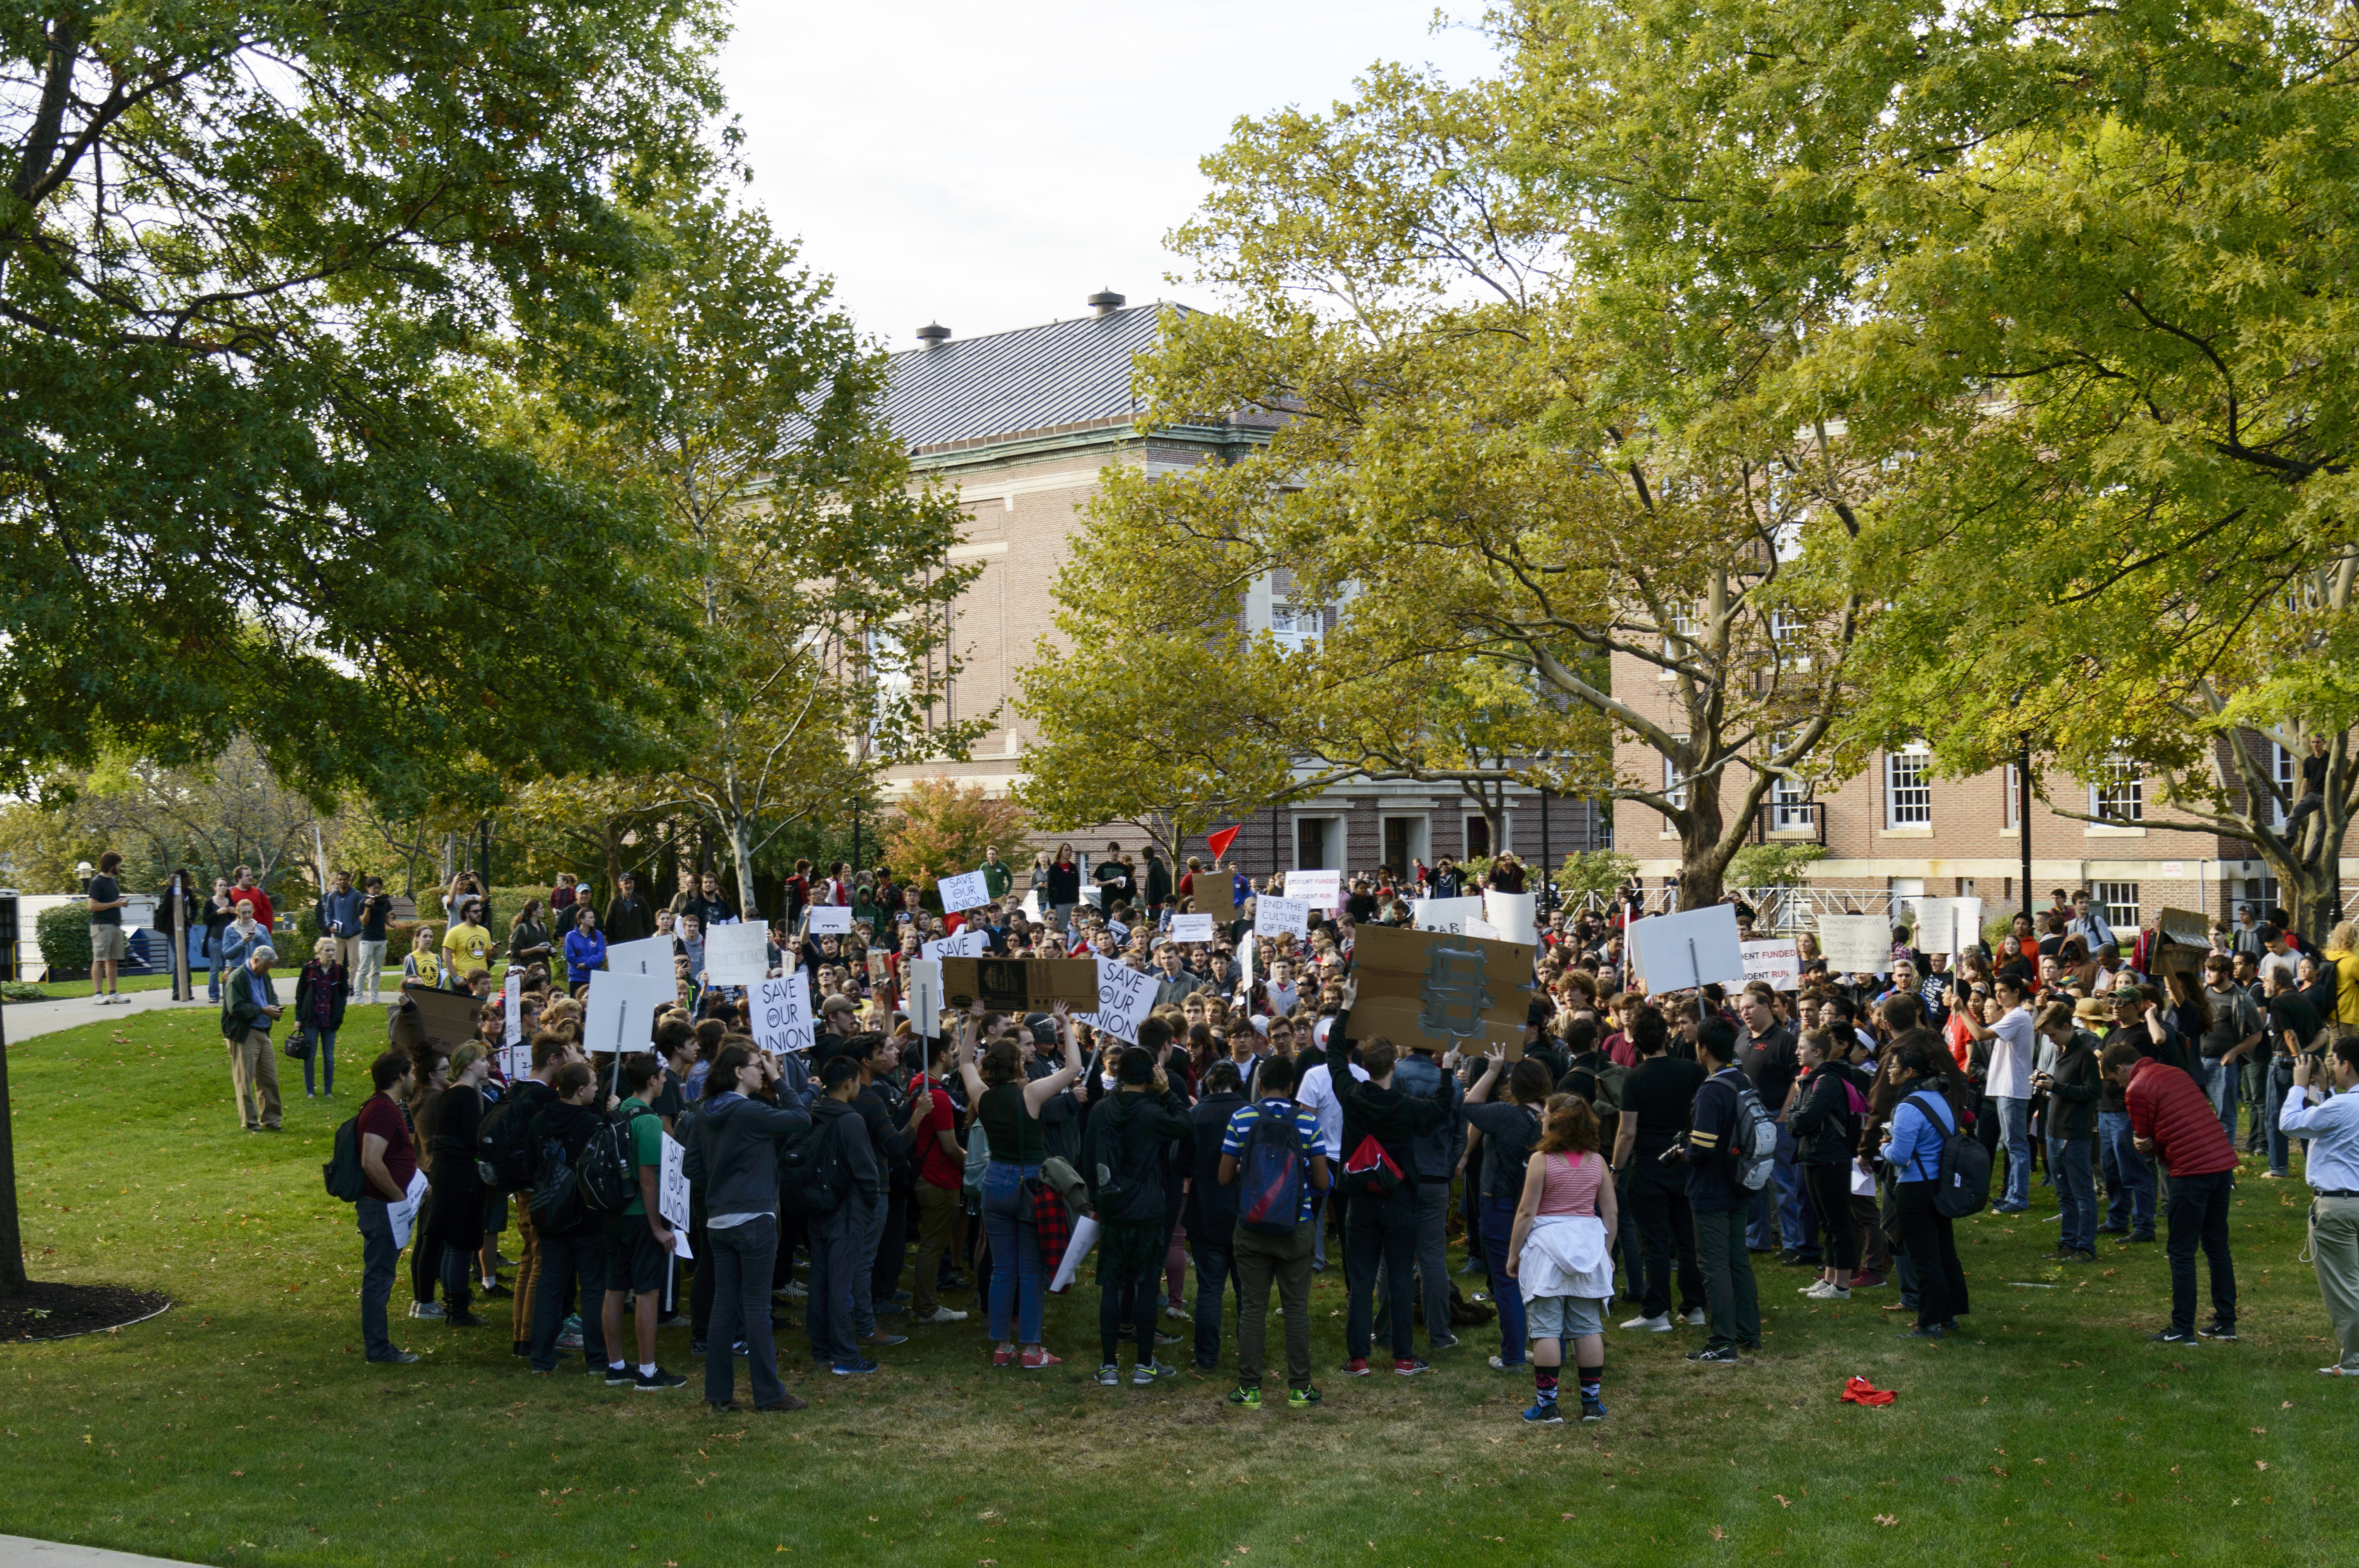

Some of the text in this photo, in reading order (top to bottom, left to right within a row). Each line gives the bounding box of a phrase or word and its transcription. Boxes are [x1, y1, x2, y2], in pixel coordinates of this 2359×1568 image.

[949, 874, 975, 888] SAVE
[953, 886, 977, 898] OUR
[947, 894, 987, 912] UNION
[1264, 899, 1303, 911] END THE
[1263, 911, 1302, 923] CULTURE
[1263, 923, 1299, 935] OF FEAR
[1837, 939, 1856, 947] removal
[1859, 938, 1865, 947] of
[937, 937, 970, 961] SAVE
[1762, 949, 1796, 959] FUNDED
[1849, 947, 1863, 958] body
[1864, 947, 1879, 955] from
[1104, 963, 1145, 994] SAVE
[1772, 970, 1789, 978] RUN
[762, 978, 797, 1004] SAVE
[1101, 990, 1112, 1000] RPI
[1099, 985, 1134, 1014] OUR
[767, 1004, 798, 1028] OUR
[769, 1014, 778, 1022] RPI
[503, 1048, 525, 1060] Fee
[669, 1140, 685, 1167] SAV
[669, 1169, 684, 1199] OUR
[663, 1191, 688, 1229] UNION
